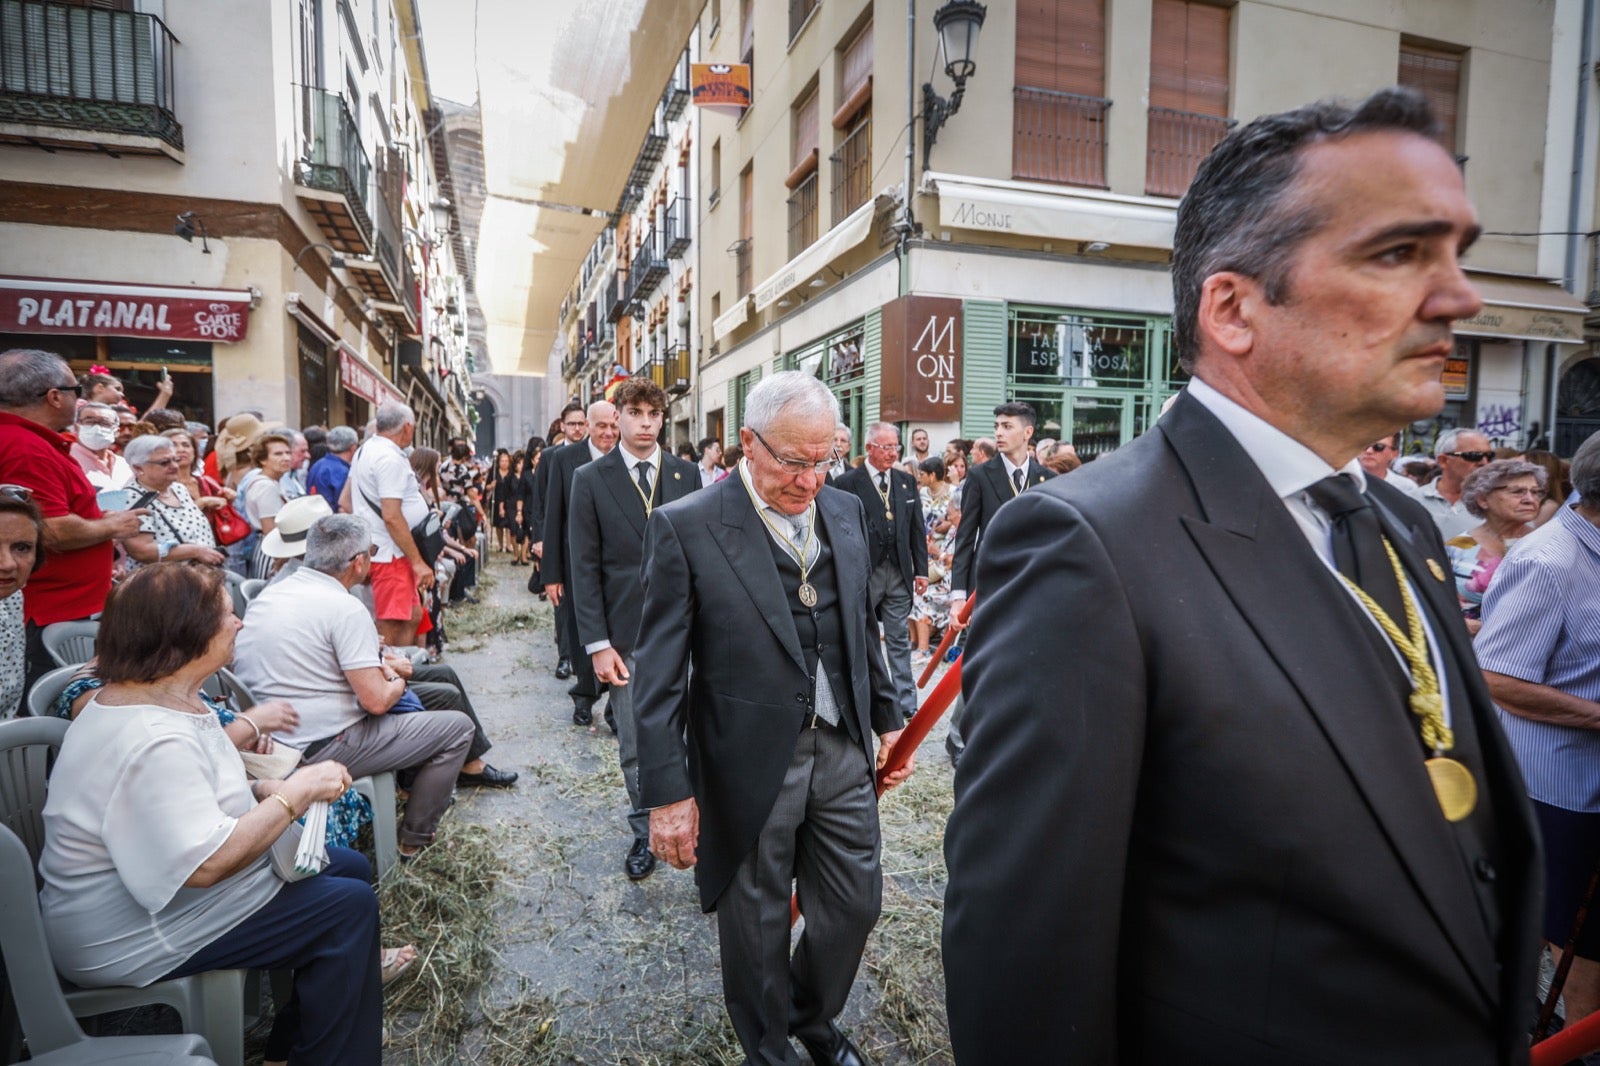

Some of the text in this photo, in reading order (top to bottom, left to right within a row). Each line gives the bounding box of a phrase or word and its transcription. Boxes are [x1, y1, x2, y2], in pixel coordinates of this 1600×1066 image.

[952, 203, 1012, 229] MONJE
[17, 297, 172, 331] PLATANAL
[194, 311, 241, 327] CARTE
